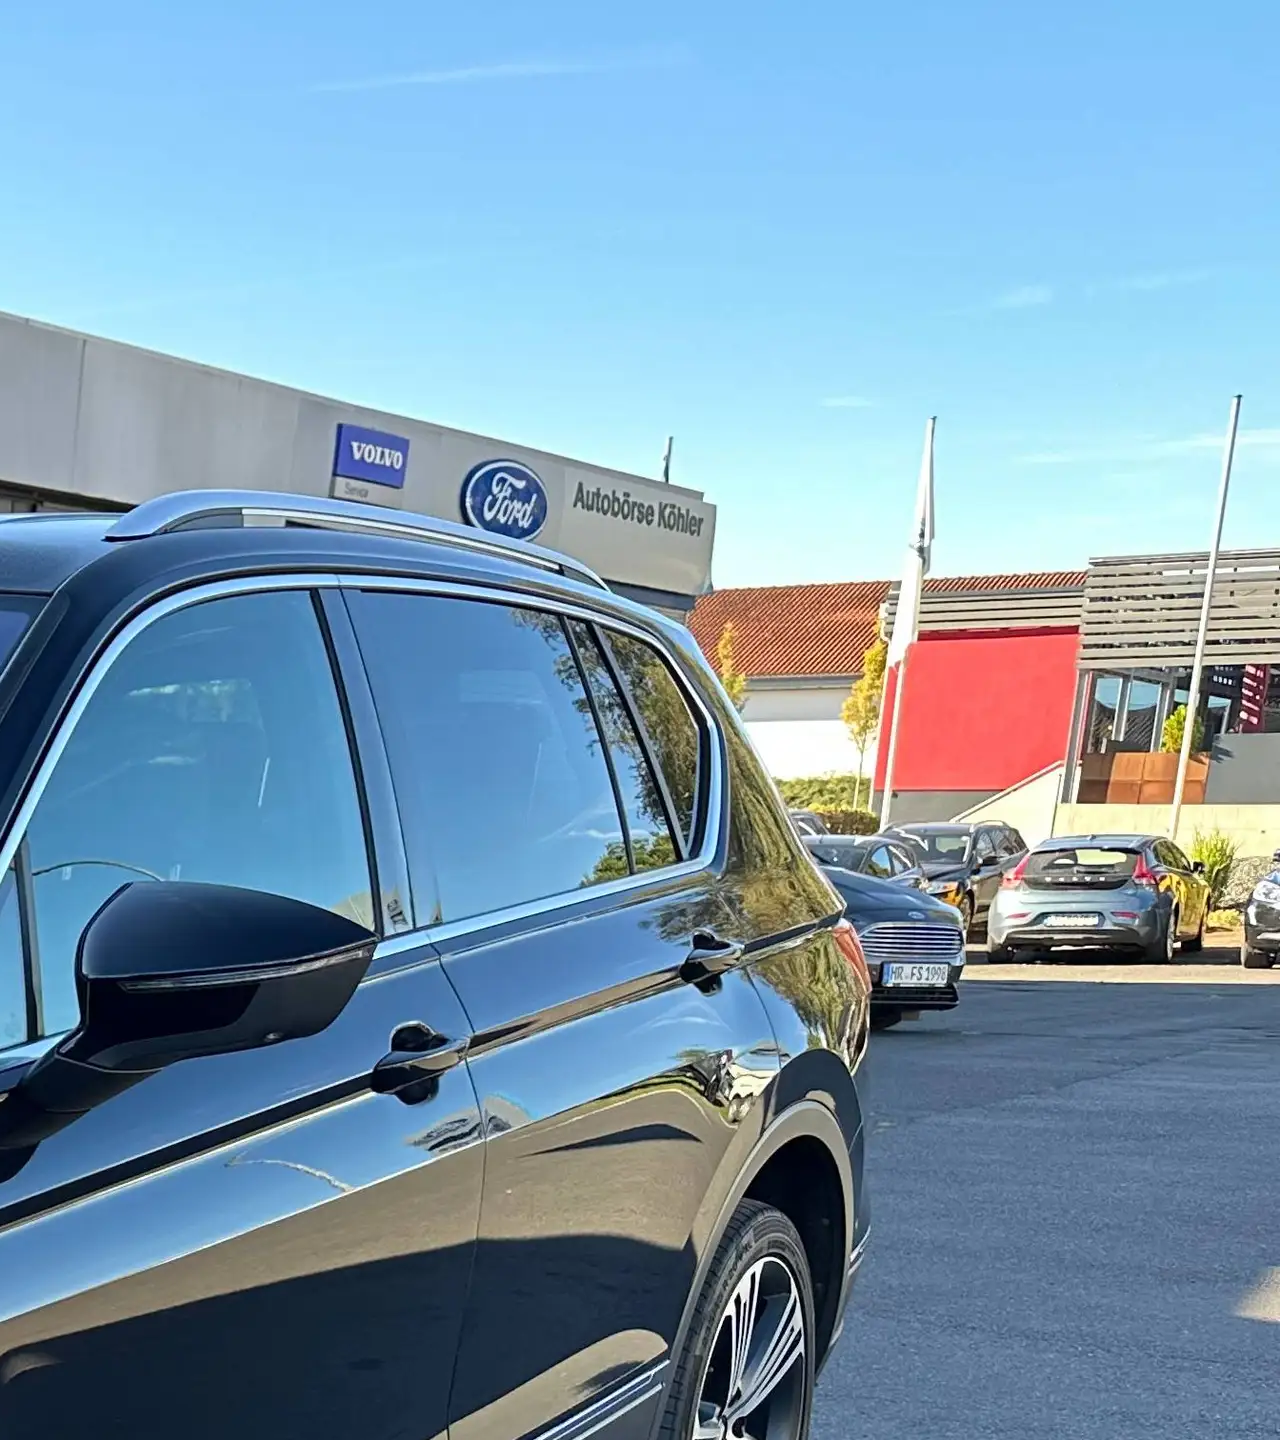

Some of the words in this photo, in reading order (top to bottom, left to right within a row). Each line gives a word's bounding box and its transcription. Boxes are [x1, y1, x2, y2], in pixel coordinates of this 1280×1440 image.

[350, 441, 403, 470] VOLVO
[483, 471, 534, 531] Ford
[573, 481, 655, 526] Autobörse
[657, 501, 704, 537] Köhler
[911, 966, 924, 981] FS
